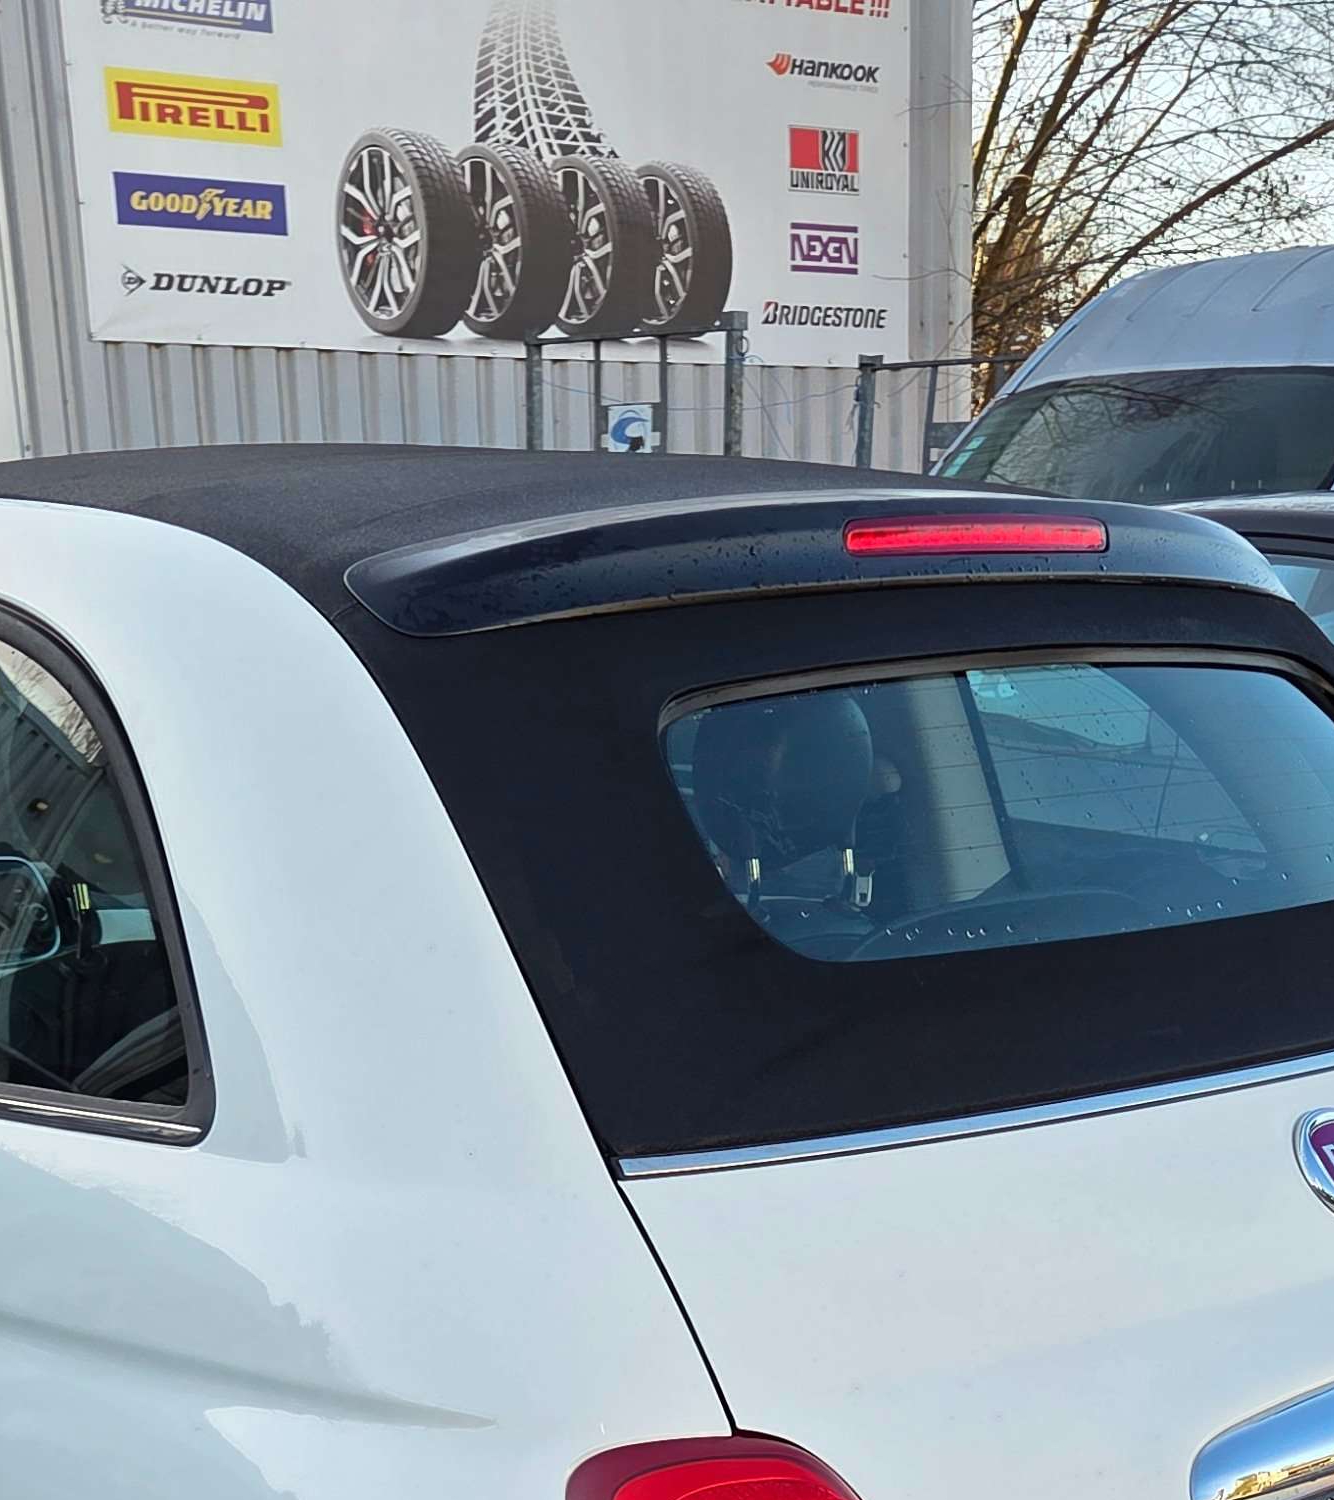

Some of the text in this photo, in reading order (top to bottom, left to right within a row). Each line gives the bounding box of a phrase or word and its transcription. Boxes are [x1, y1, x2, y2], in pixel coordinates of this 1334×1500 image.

[114, 80, 270, 133] PIRELLI
[790, 170, 860, 192] UNIROYAL
[130, 188, 274, 220] GOODYEAR
[790, 233, 858, 265] NEXEN
[150, 272, 290, 297] DUNLOP
[761, 301, 888, 329] BRIDGESTONE
